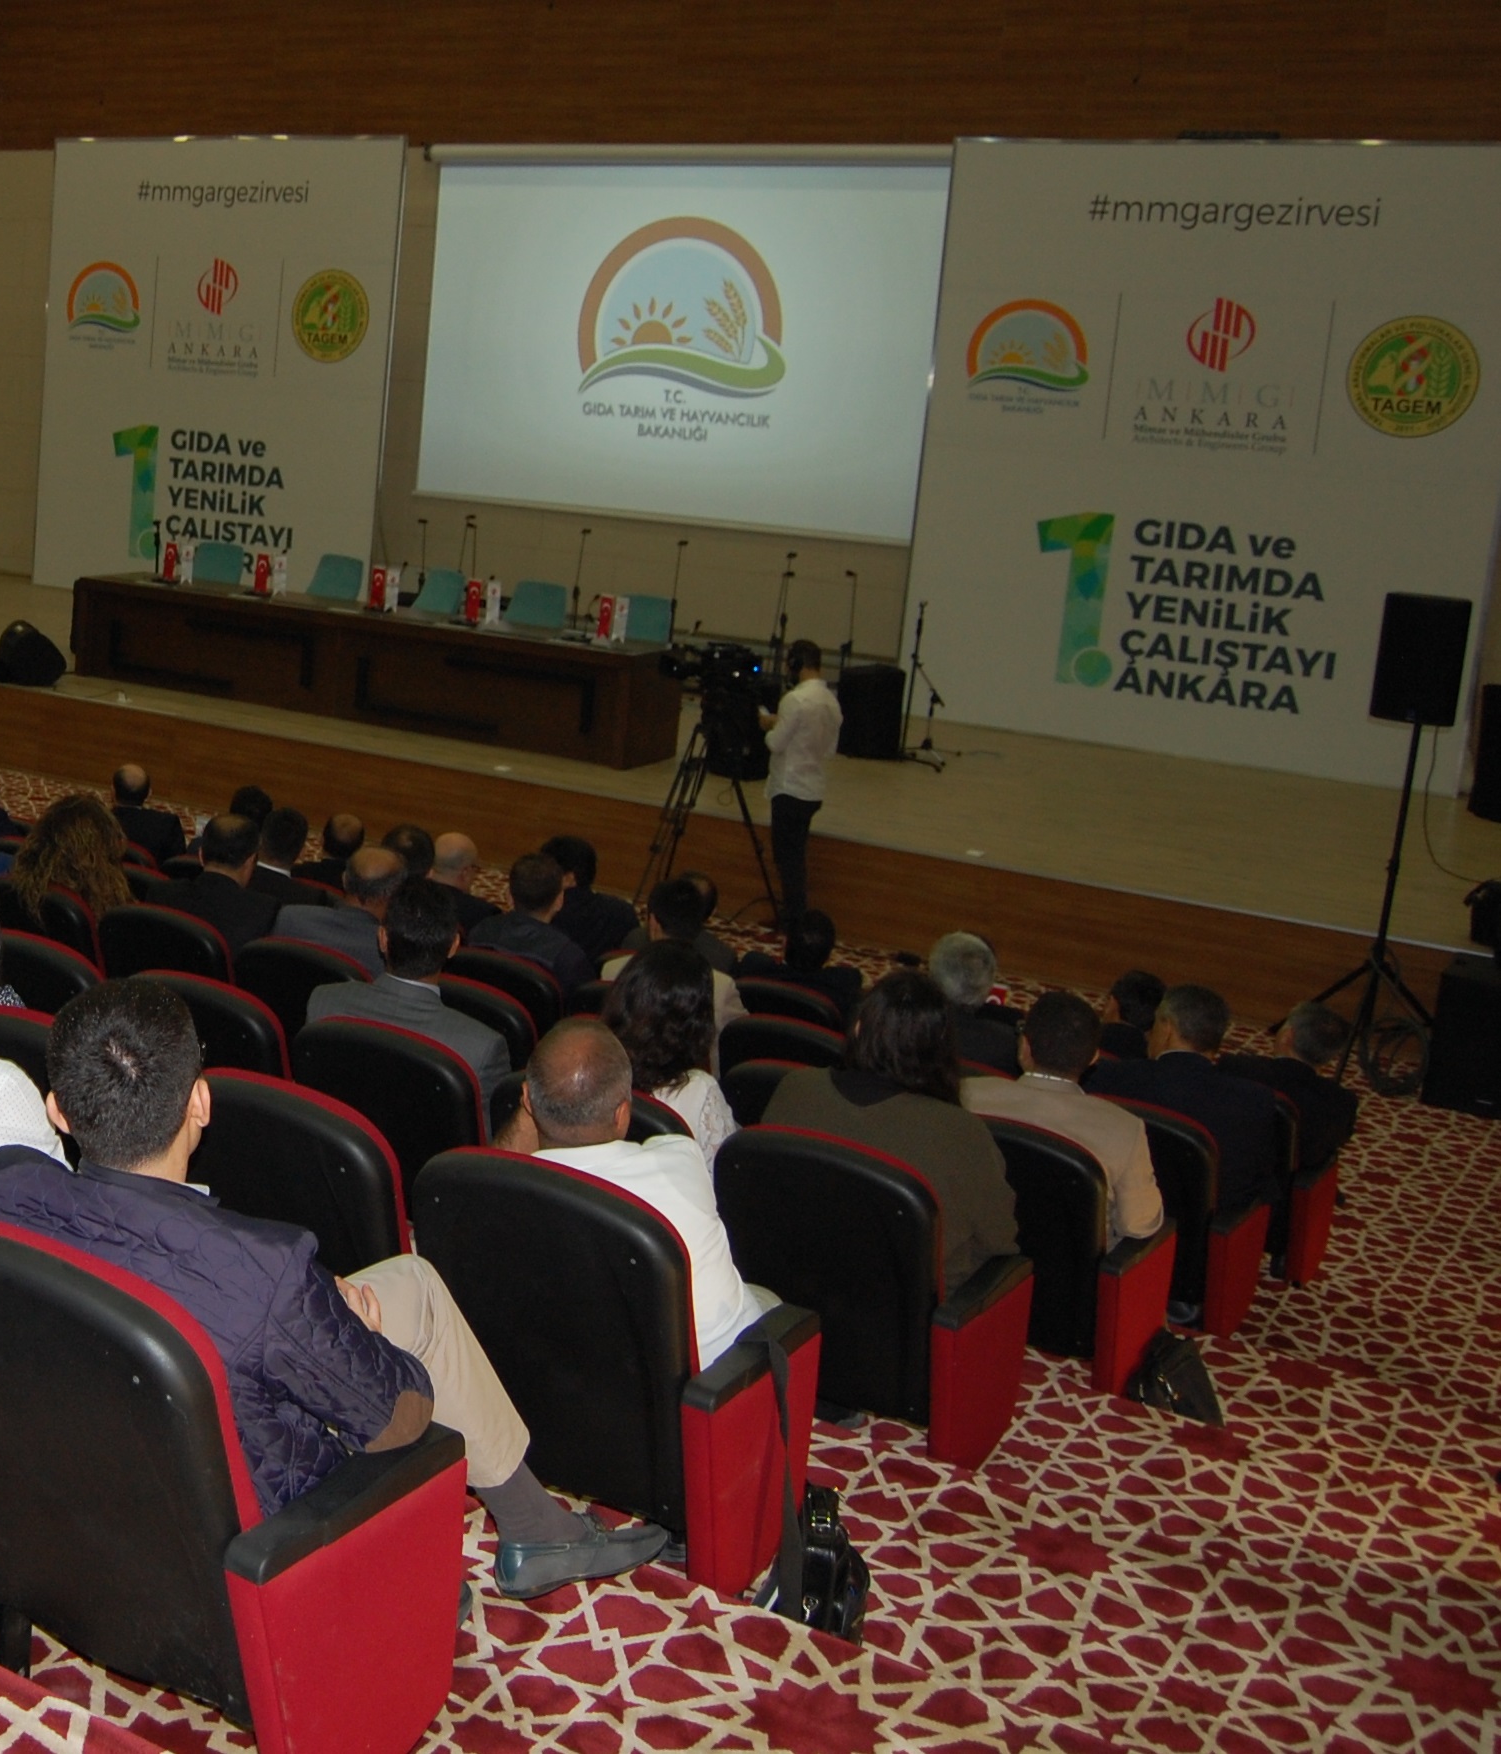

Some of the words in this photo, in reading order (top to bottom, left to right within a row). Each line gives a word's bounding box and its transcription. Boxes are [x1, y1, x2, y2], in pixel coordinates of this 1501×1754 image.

[137, 180, 310, 208] #mmgargezirvesi
[1089, 194, 1381, 231] #mmgargezirvesi
[167, 341, 258, 359] ANKARA
[307, 333, 348, 345] TAGEM
[663, 389, 686, 404] T.C.
[1372, 397, 1442, 415] TAGEM
[582, 402, 615, 417] GIDA
[619, 404, 656, 420] TARIM
[661, 407, 677, 422] VE
[680, 407, 771, 429] HAYVANCILIK
[1133, 405, 1287, 430] ANKARA
[171, 429, 232, 456] GIDA
[238, 439, 267, 458] ve
[637, 423, 708, 442] BAKANLIĞI
[169, 457, 284, 490] TARIMDA
[1134, 519, 1237, 555] GIDA
[1248, 533, 1297, 560] ve
[1130, 555, 1325, 602] TARIMDA
[1119, 629, 1337, 680] ÇALIŞTAYI
[1113, 667, 1301, 715] ANKARA
